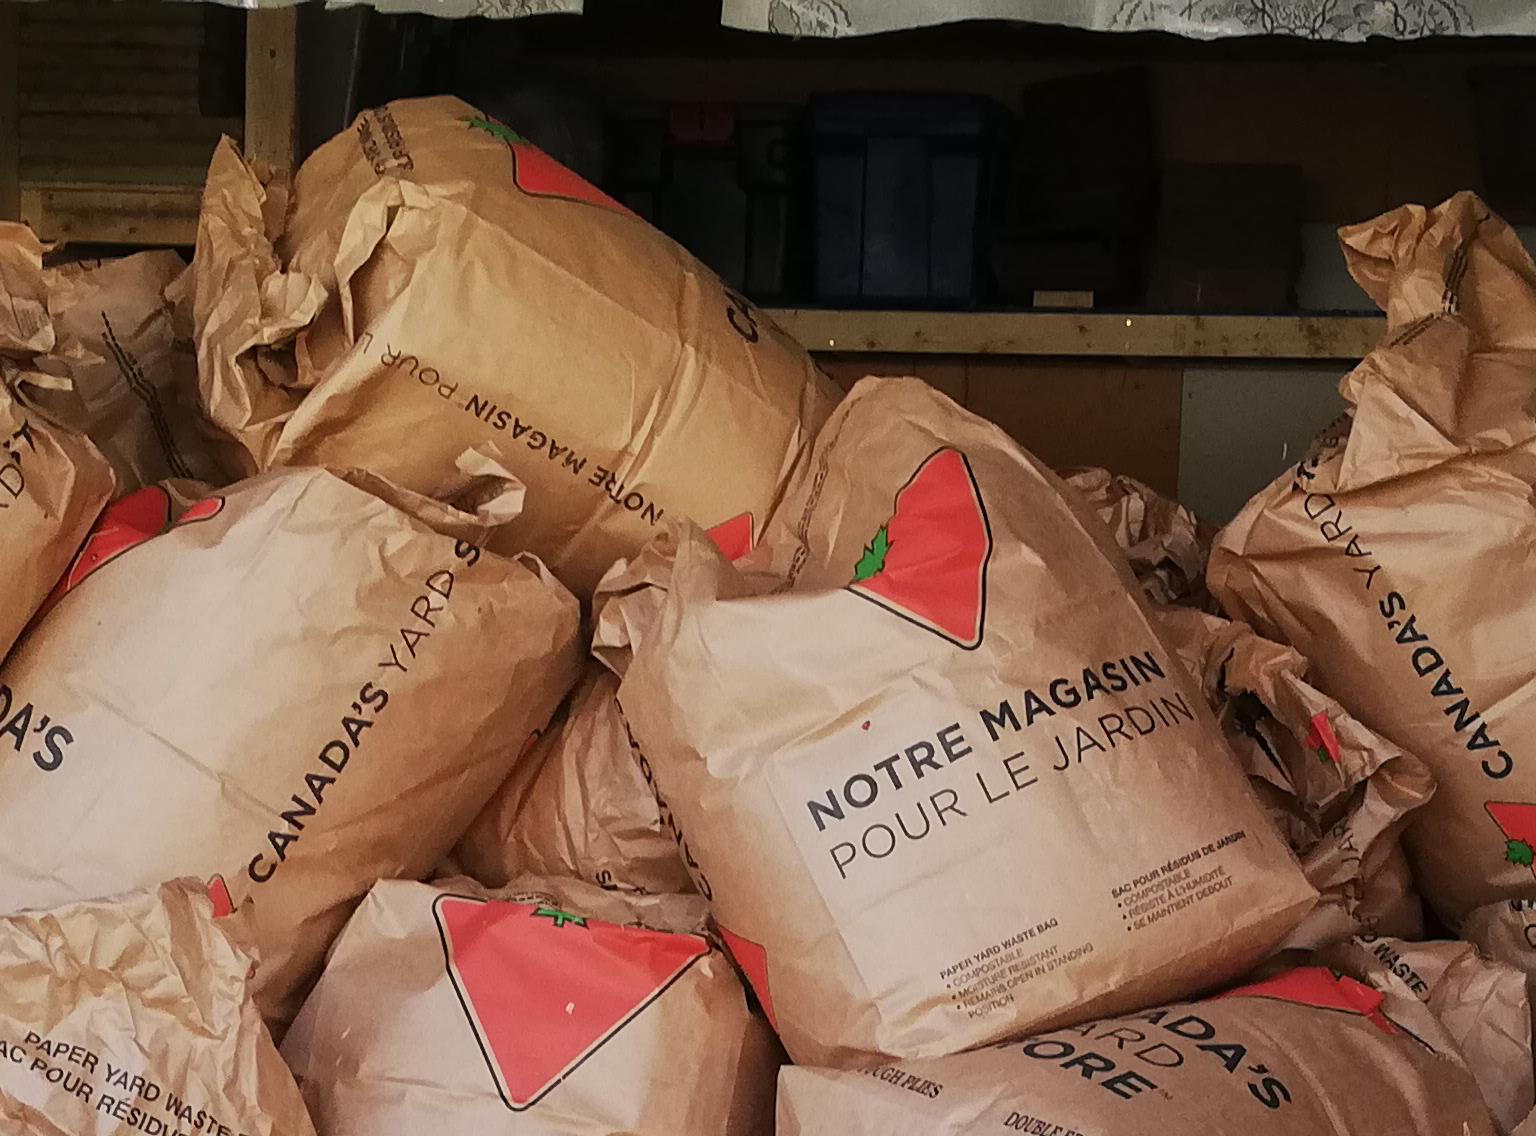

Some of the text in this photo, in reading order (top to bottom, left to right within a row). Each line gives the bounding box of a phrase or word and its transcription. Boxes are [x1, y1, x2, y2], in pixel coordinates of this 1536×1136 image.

[381, 344, 458, 400] POUR
[465, 394, 587, 475] MAGASIN
[588, 464, 664, 526] NOTRE
[1304, 494, 1381, 589] YARD
[1379, 591, 1513, 779] CANADA'S
[247, 570, 455, 884] CANADA'S YARD
[806, 722, 973, 831] NOTRE
[978, 651, 1167, 742] MAGASIN
[829, 692, 1195, 879] POUR LE JARDIN
[1133, 869, 1160, 888] POUR
[1201, 843, 1216, 856] DE
[939, 917, 1059, 980] PAPER YARD WASTE BAG
[1006, 970, 1034, 988] OPEN
[1034, 965, 1046, 976] IN
[968, 994, 1014, 1019] POSITION
[25, 1031, 99, 1074] PAPER
[105, 1063, 161, 1101] YARD
[30, 1059, 93, 1103] POUR
[1023, 1040, 1158, 1100] ORE
